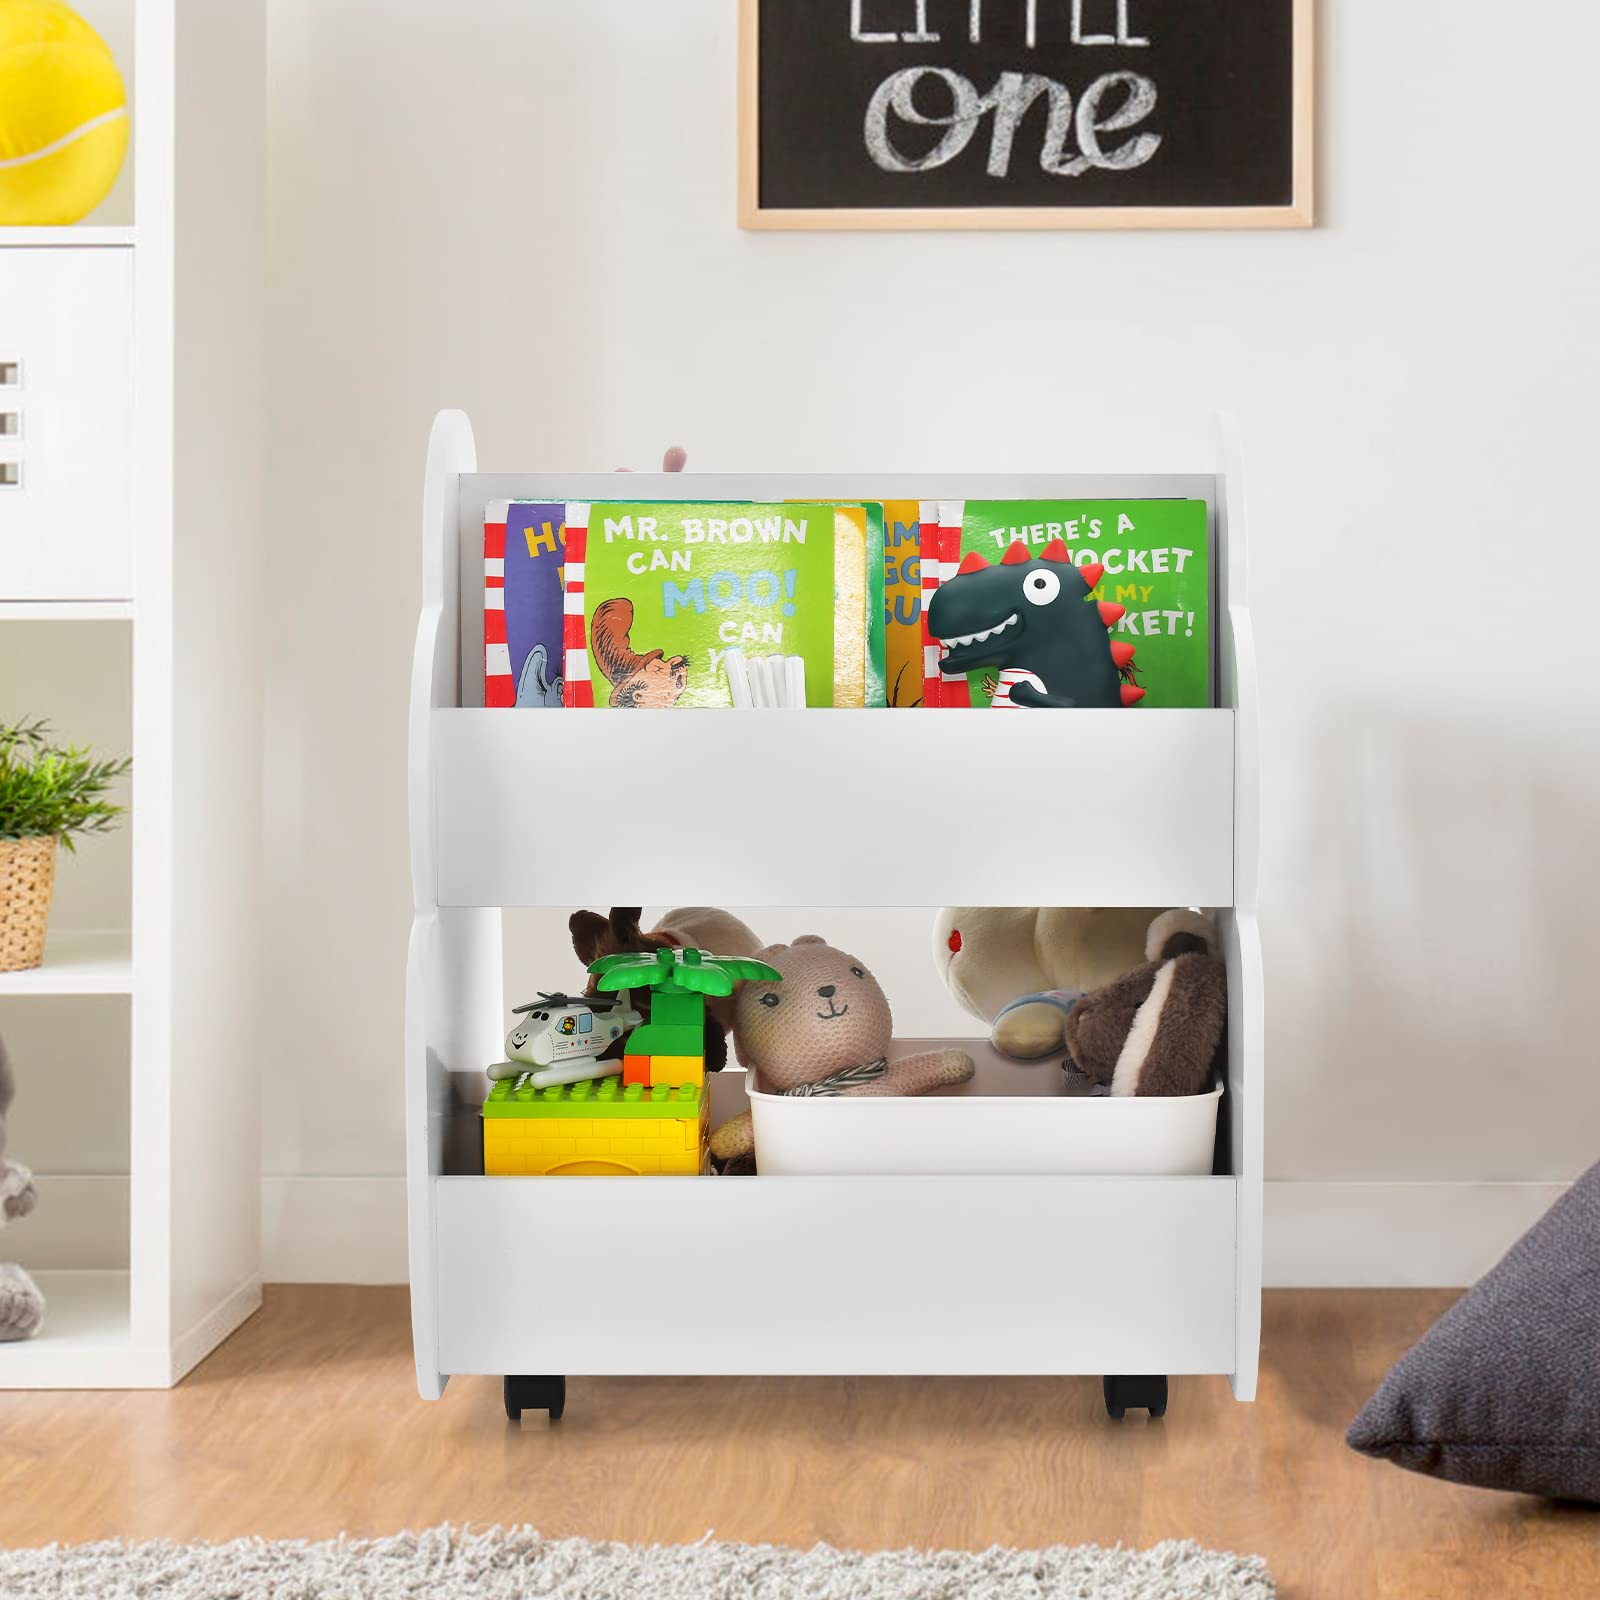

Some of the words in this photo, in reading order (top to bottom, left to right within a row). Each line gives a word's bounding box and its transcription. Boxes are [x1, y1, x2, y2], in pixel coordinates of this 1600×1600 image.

[864, 66, 1162, 178] one
[523, 521, 566, 558] H
[604, 516, 668, 543] MR.
[685, 516, 808, 544] BROWN
[989, 514, 1102, 548] THERE'S
[1117, 513, 1135, 535] A
[627, 549, 692, 575] CAN
[1067, 547, 1193, 574] OCKET
[662, 569, 798, 618] MOO!
[1115, 583, 1153, 603] MY
[718, 620, 784, 644] CAN
[1107, 610, 1195, 638] KET!
